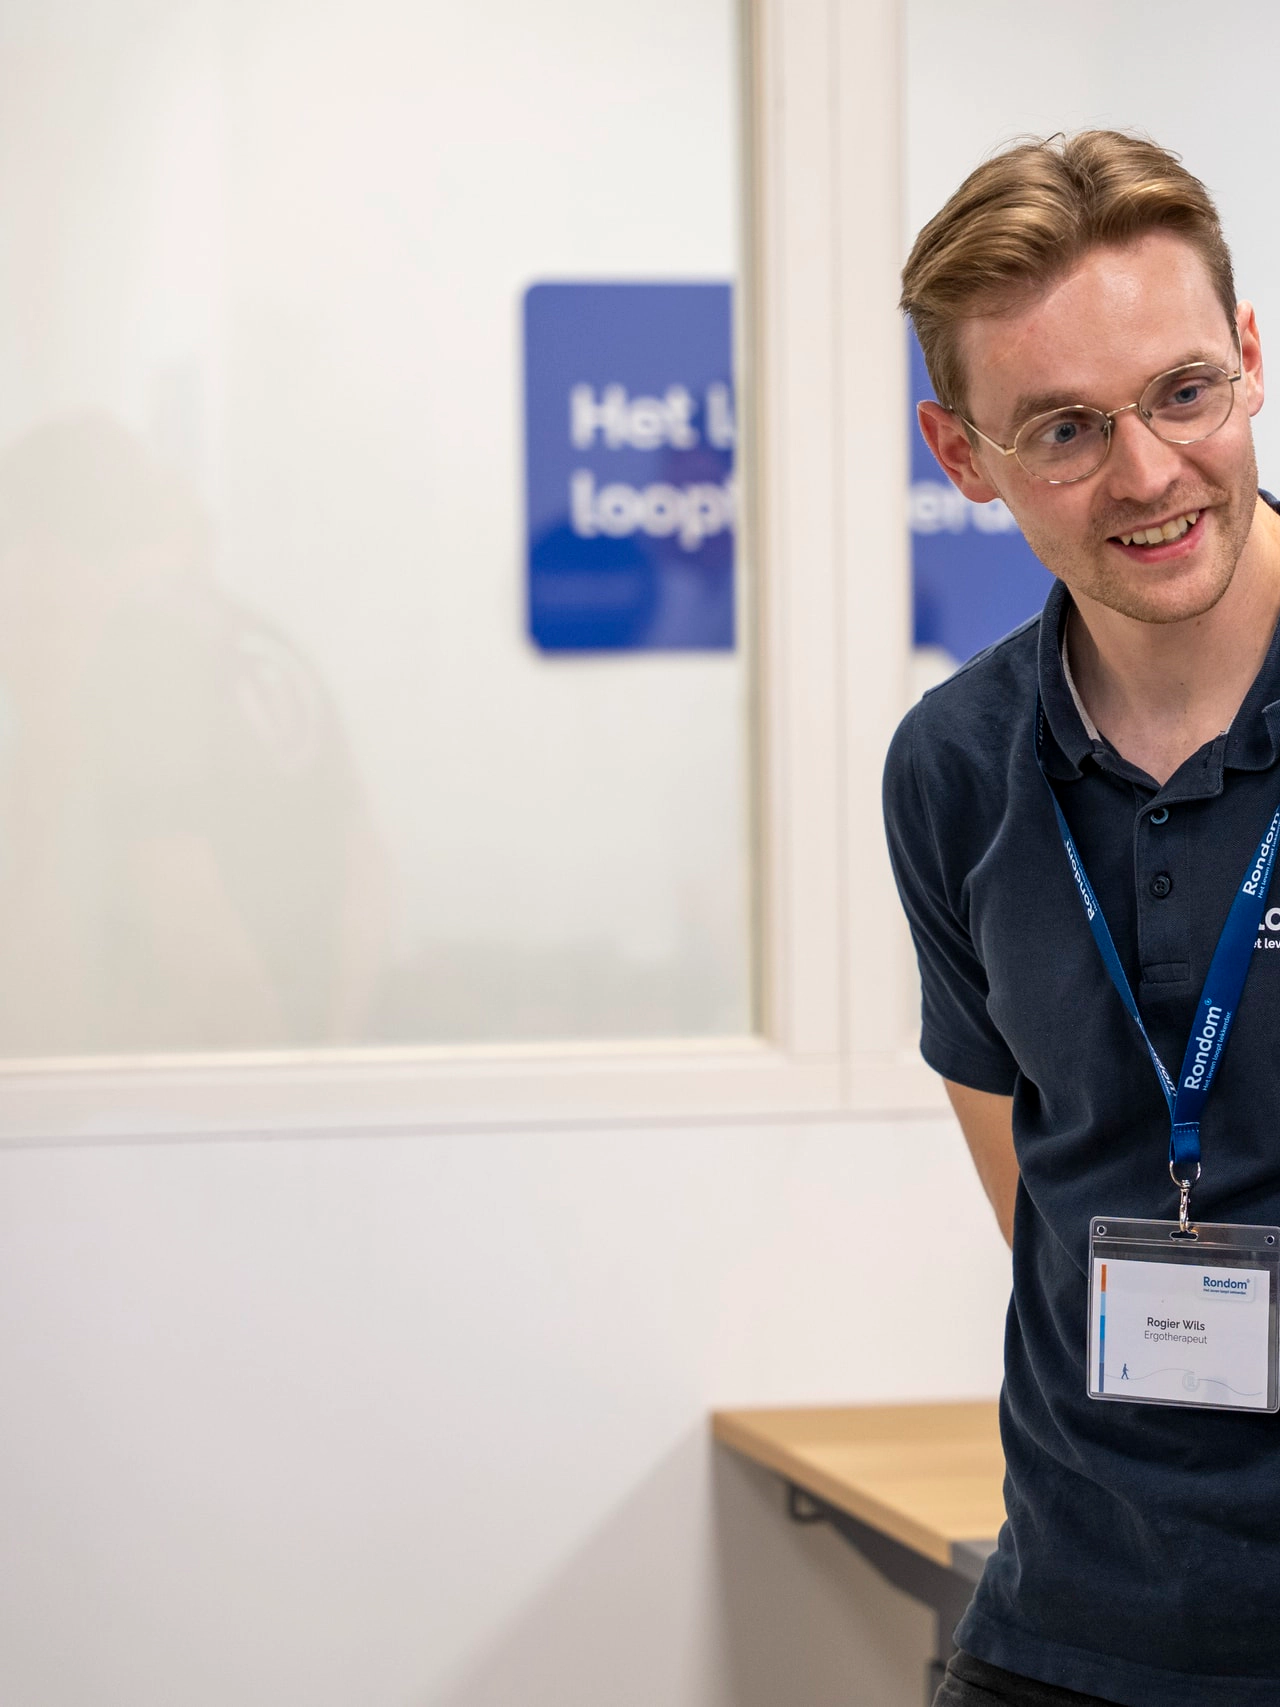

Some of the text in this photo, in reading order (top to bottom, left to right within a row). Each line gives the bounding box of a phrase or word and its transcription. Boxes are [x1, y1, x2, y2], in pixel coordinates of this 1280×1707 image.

[571, 381, 698, 450] Het
[1203, 1276, 1247, 1290] Rondom
[1146, 1316, 1206, 1331] Rogier Wils
[1144, 1330, 1208, 1345] Ergotherapeut
